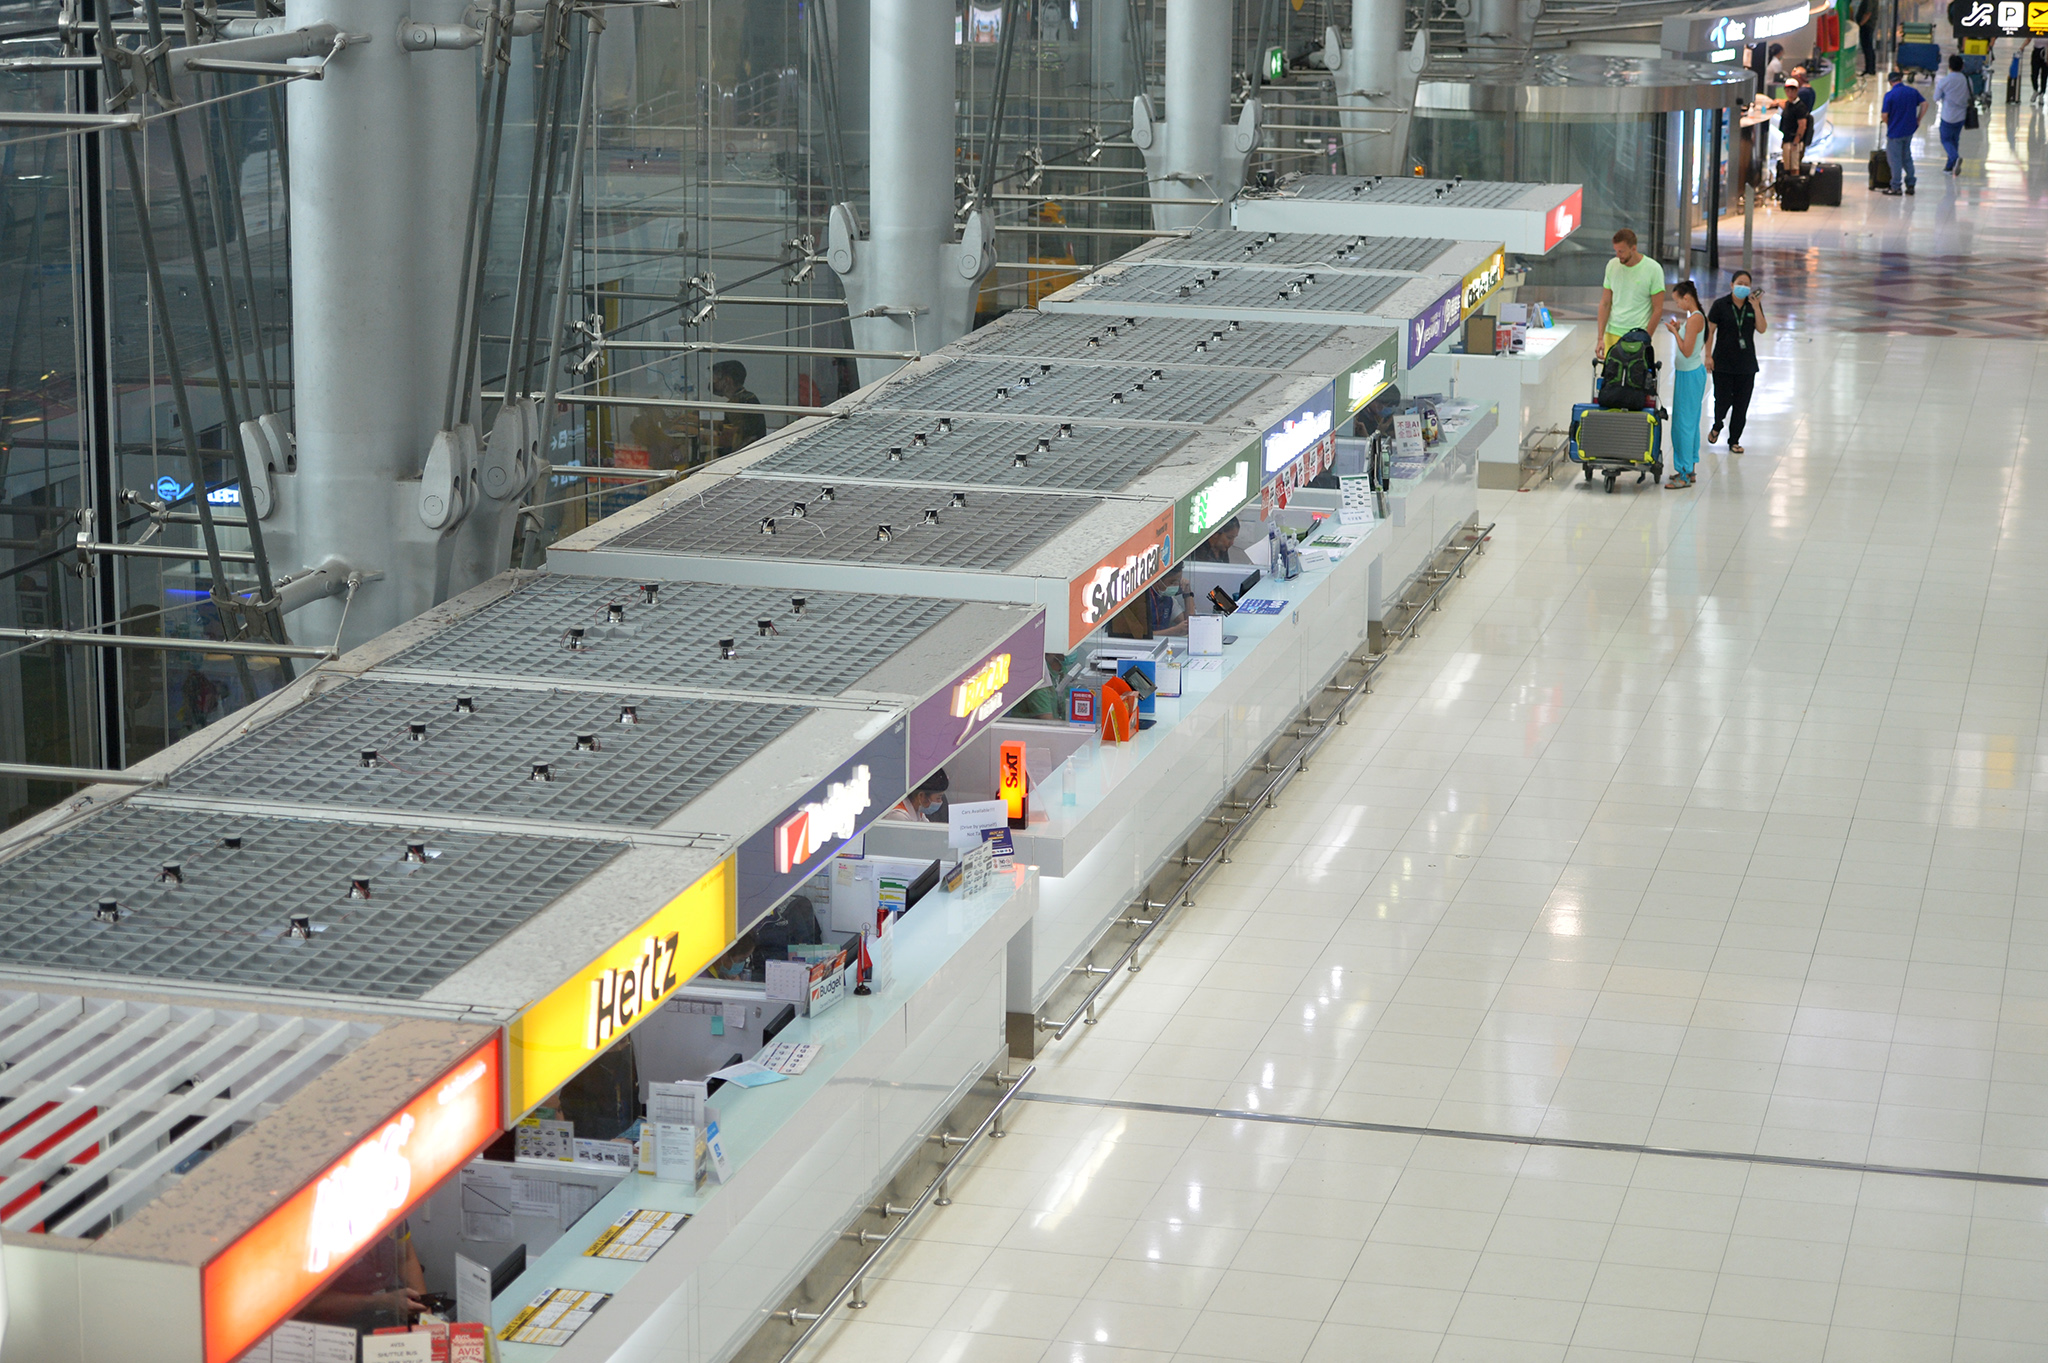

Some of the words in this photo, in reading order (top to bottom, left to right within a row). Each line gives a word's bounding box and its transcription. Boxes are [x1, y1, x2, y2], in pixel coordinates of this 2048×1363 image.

[2005, 7, 2017, 21] P
[1146, 544, 1160, 580] car
[1005, 752, 1018, 788] SIXT
[590, 931, 679, 1050] Hertz
[819, 977, 842, 998] Budget
[457, 1347, 481, 1356] AVIS
